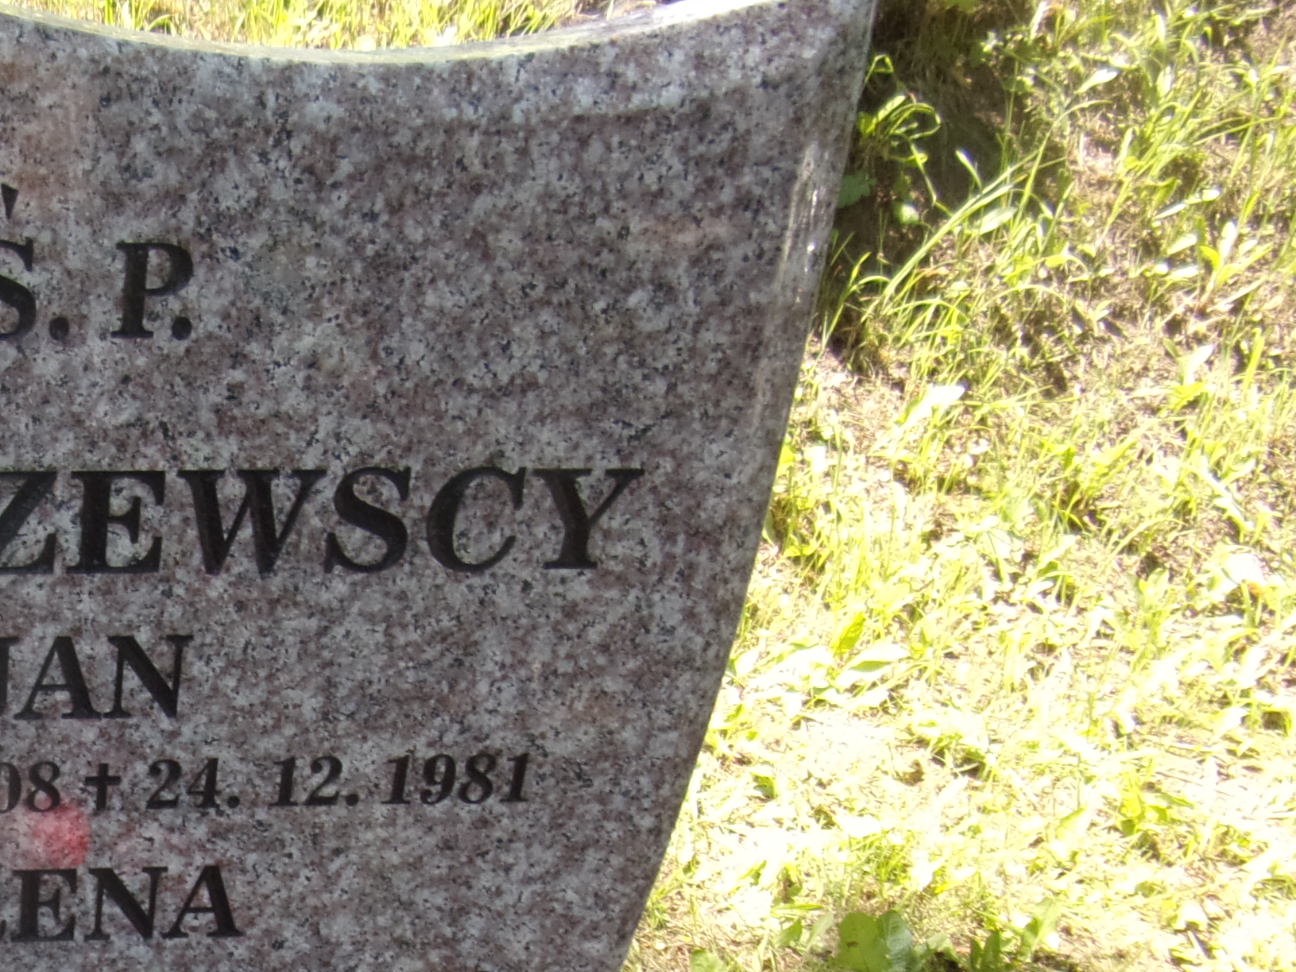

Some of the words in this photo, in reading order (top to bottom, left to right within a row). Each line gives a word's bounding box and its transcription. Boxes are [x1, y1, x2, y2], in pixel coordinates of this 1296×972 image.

[146, 757, 241, 810] 24.
[268, 754, 361, 806] 12.
[380, 751, 530, 805] 1981
